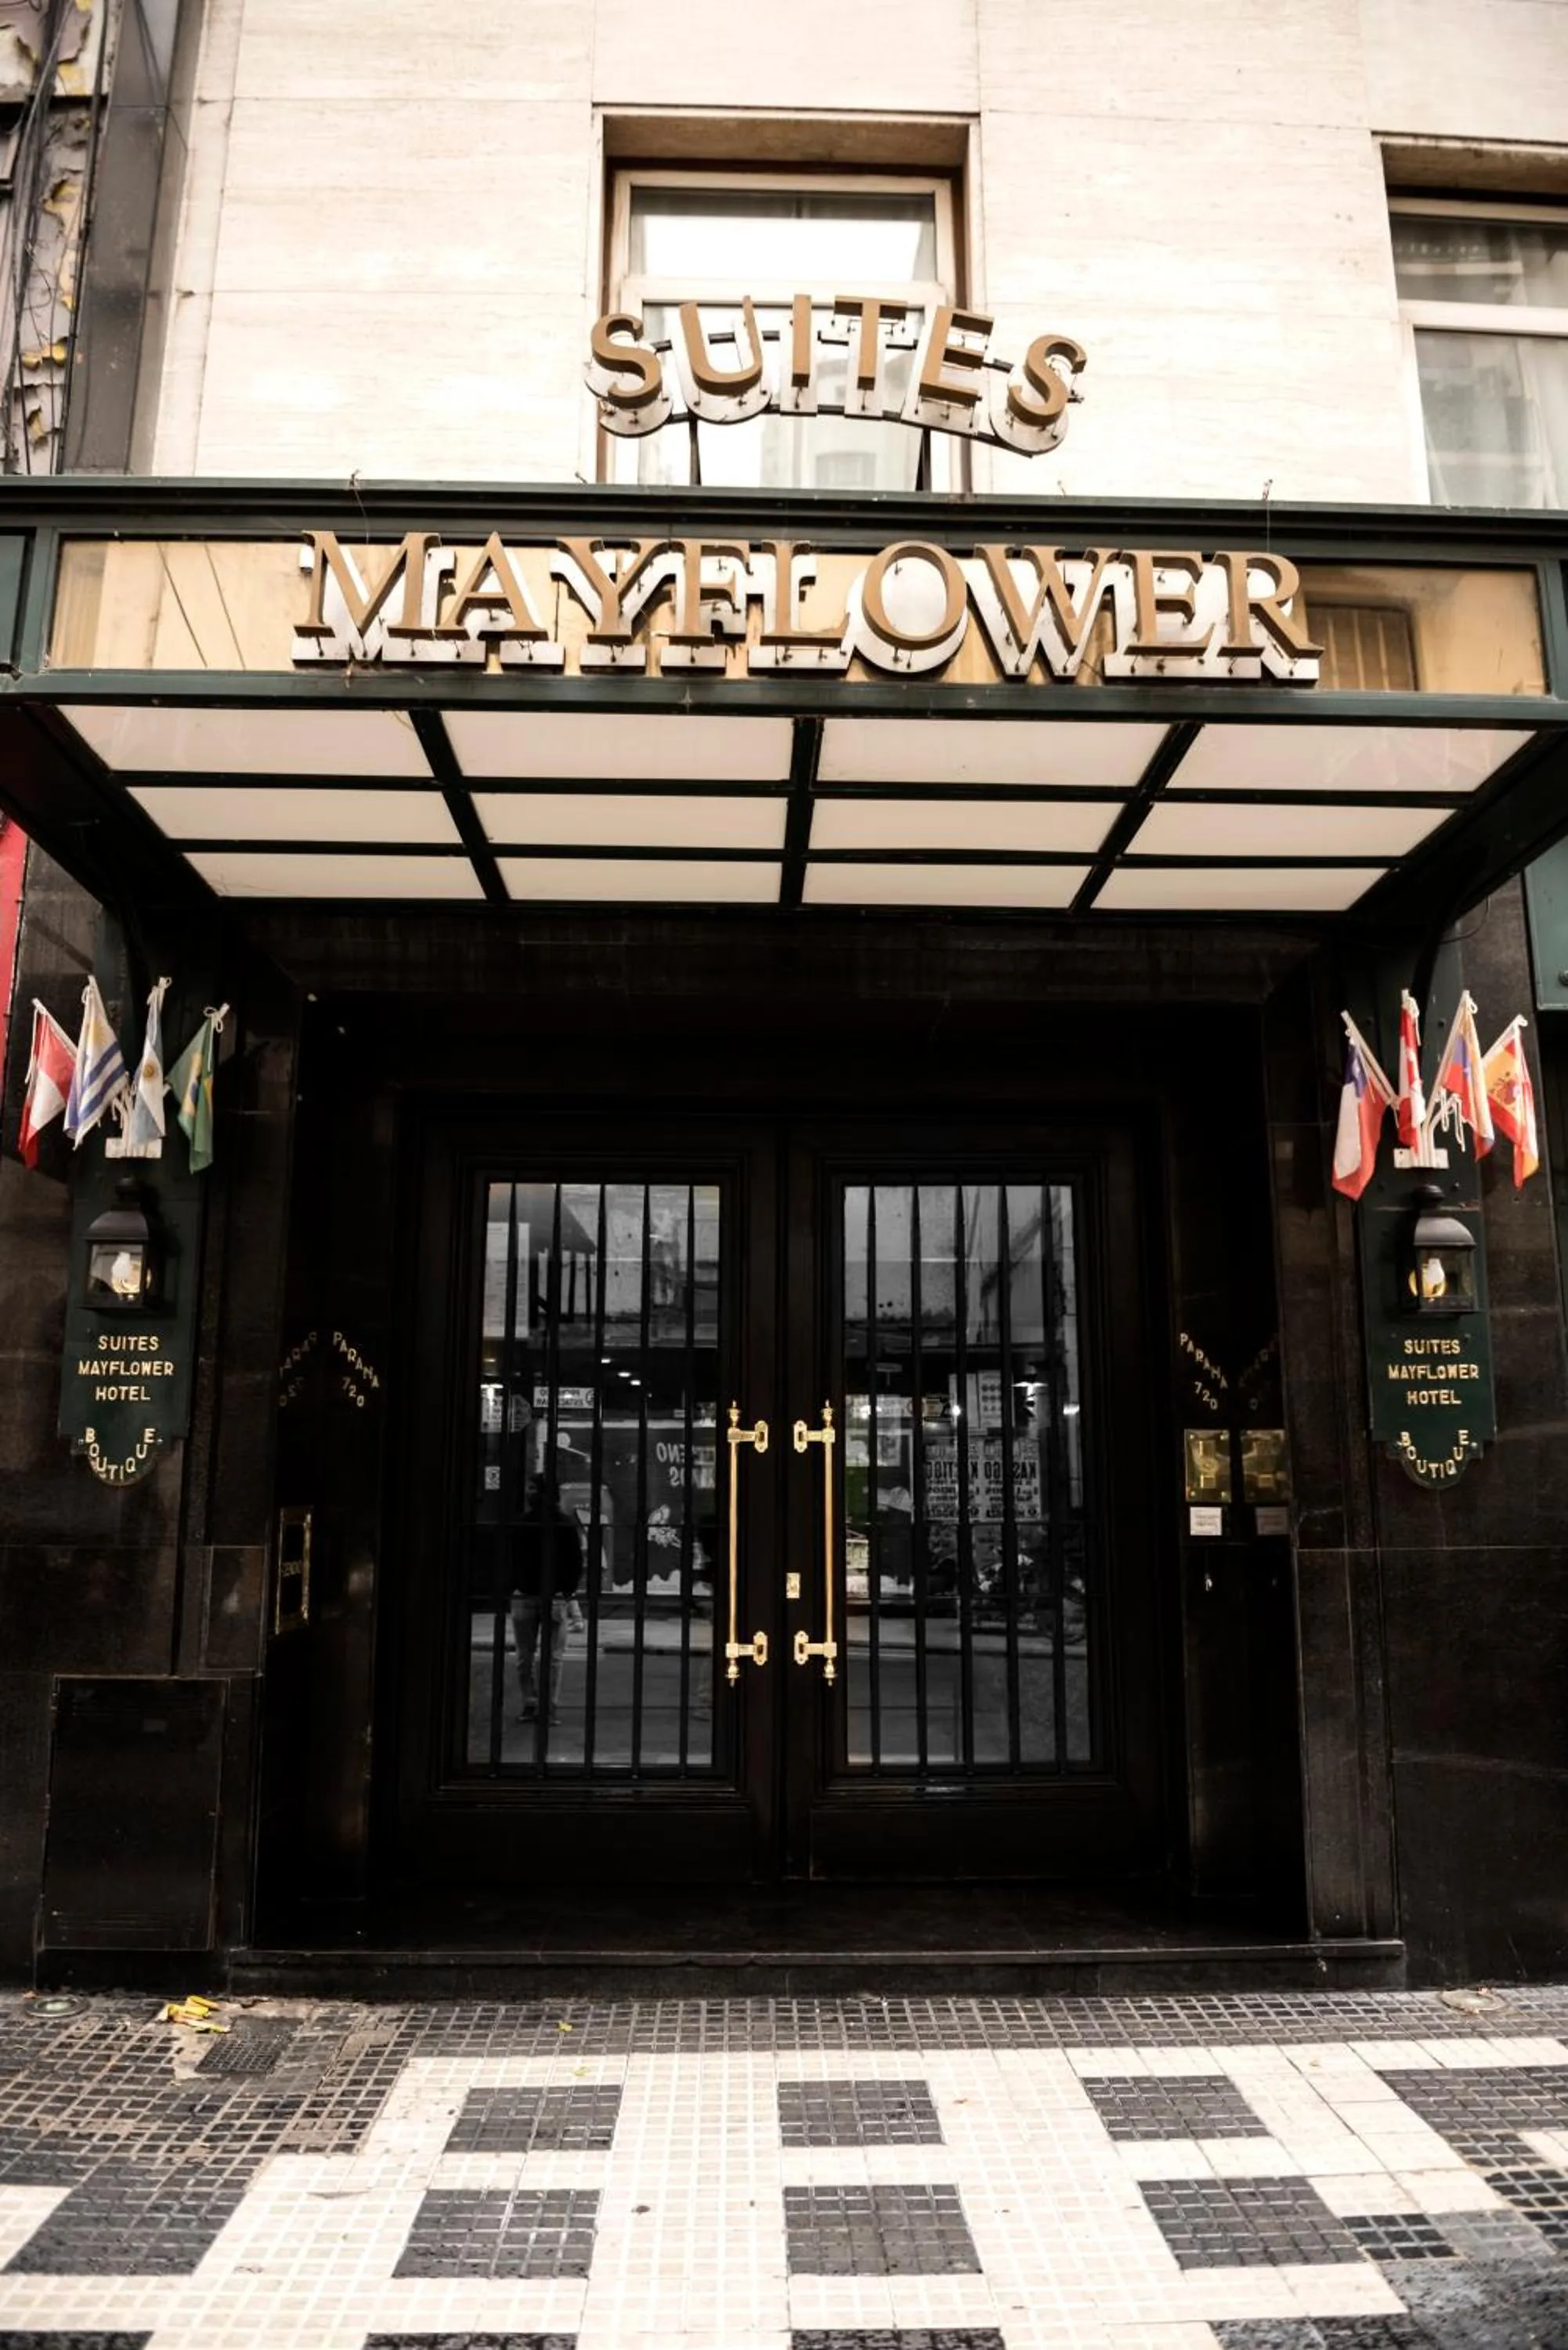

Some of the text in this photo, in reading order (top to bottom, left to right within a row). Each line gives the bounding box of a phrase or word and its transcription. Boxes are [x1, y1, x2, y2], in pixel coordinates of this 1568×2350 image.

[589, 293, 1087, 436] SUITES
[293, 531, 1324, 674] MAYFLOWER
[98, 1335, 160, 1351] SUITES
[1404, 1339, 1461, 1354] SUITES
[78, 1360, 174, 1376] MAYFLOWER
[1388, 1364, 1479, 1379] MAYFLOWER
[95, 1386, 151, 1401] HOTEL
[341, 1376, 366, 1408] 720
[1194, 1381, 1219, 1411] 720
[1407, 1390, 1462, 1405] HOTEL
[85, 1426, 157, 1481] BOUTIQUE
[1400, 1429, 1470, 1479] BOUTIQUE
